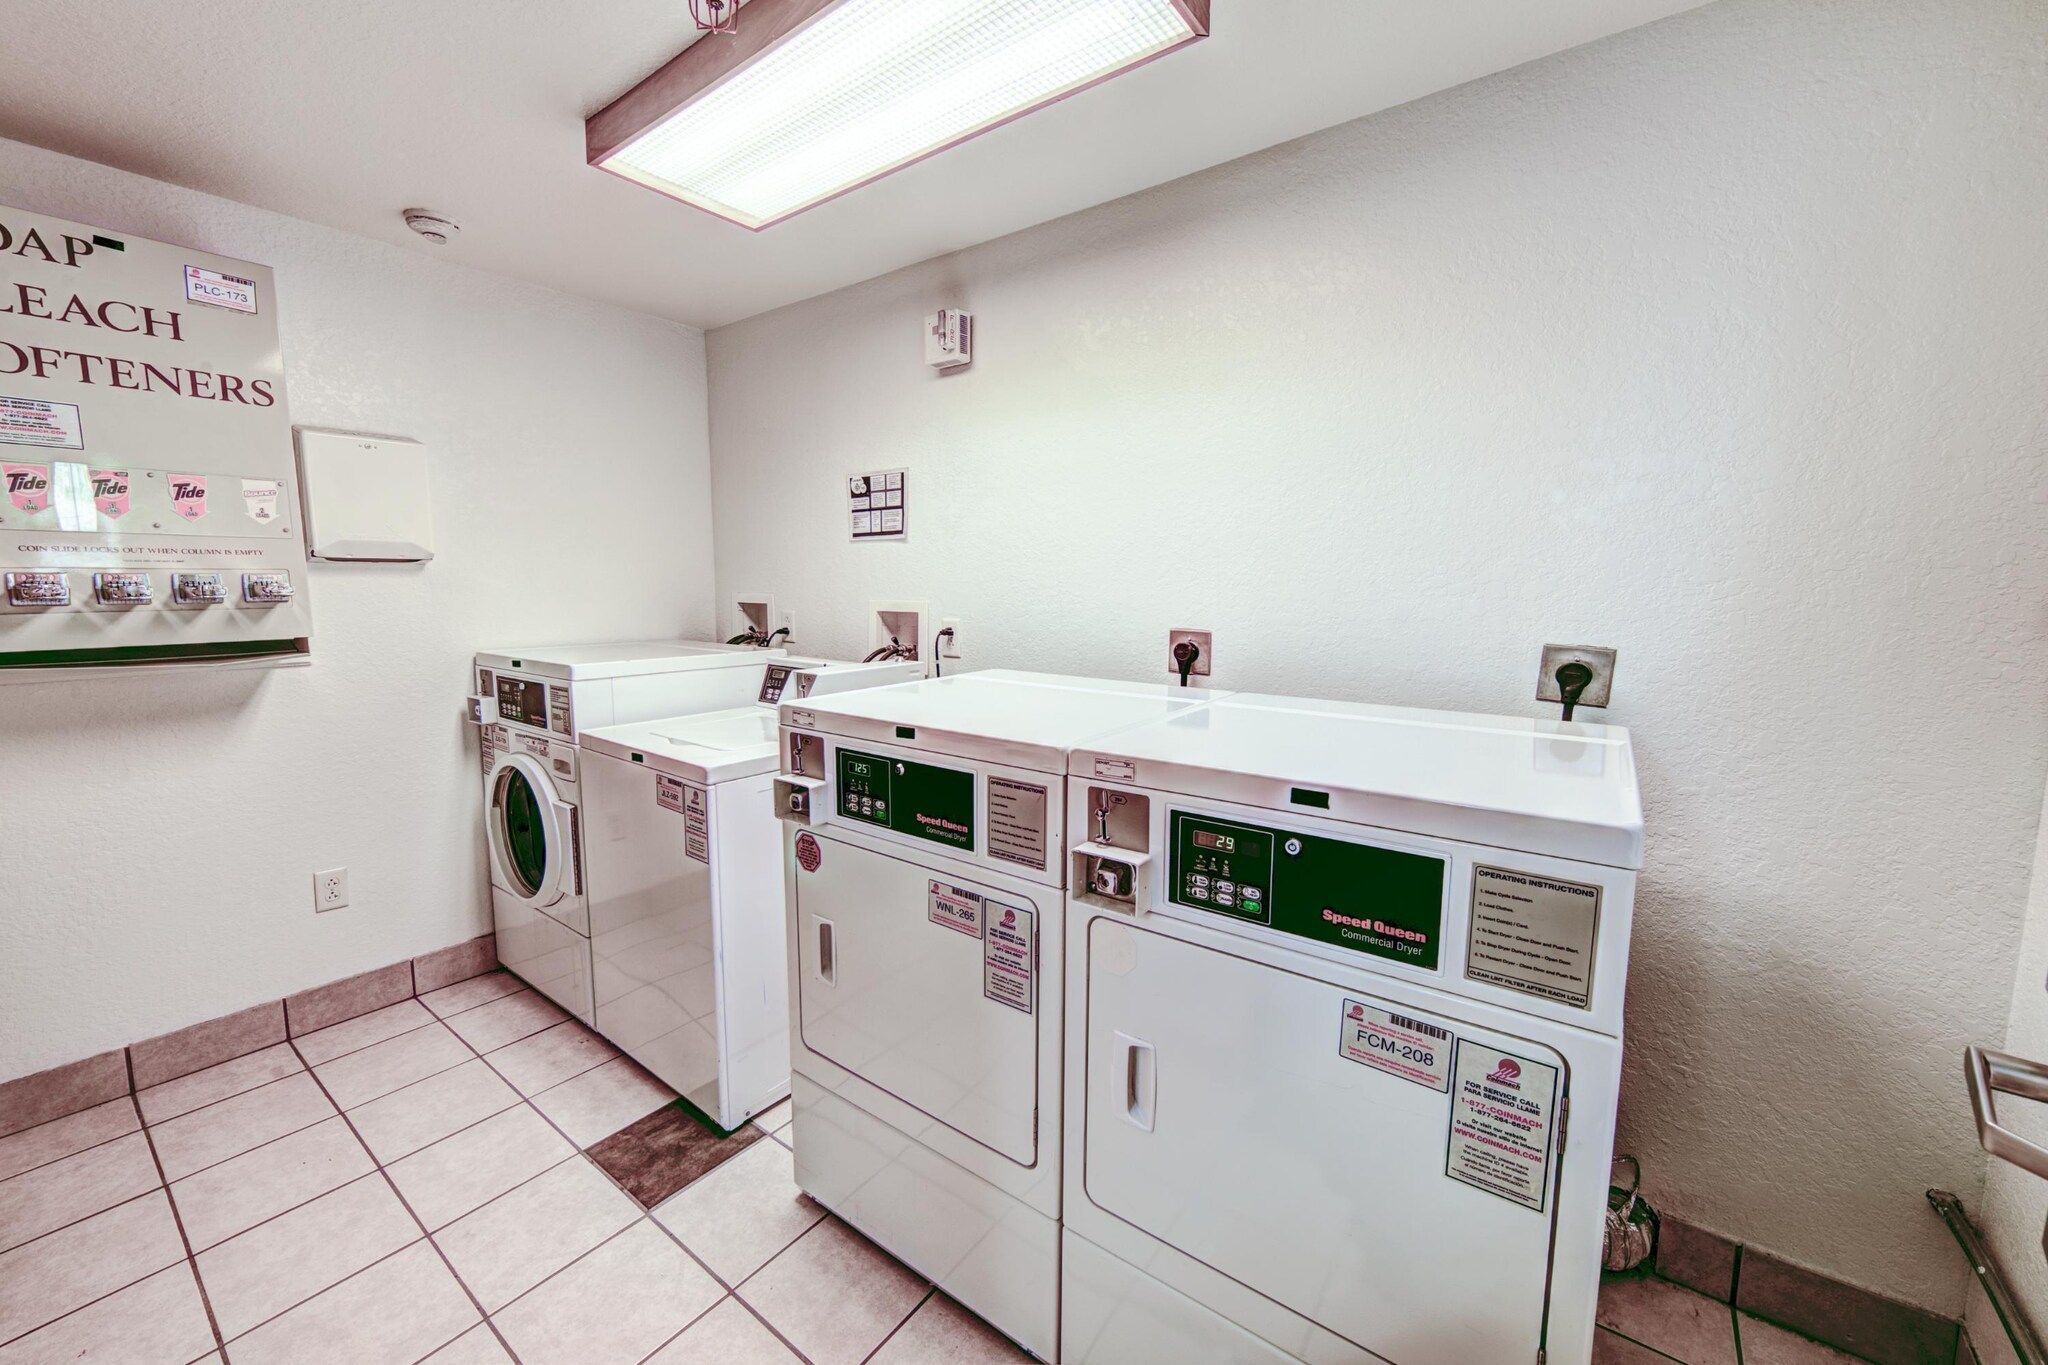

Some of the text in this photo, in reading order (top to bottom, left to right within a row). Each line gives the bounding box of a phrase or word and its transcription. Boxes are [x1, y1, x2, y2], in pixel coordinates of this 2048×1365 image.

[195, 283, 248, 302] PLC-173
[6, 472, 47, 493] Tide
[92, 479, 128, 497] Tide
[172, 483, 205, 501] Tide
[855, 762, 867, 774] 125
[916, 813, 968, 833] Speed Queen
[926, 826, 967, 842] Commercial Dryer
[1216, 835, 1234, 850] 29
[1478, 869, 1594, 898] OPERATING INSTRUCTIONS
[935, 900, 976, 922] WNL-265
[1322, 908, 1427, 943] Speed Queen
[1341, 928, 1422, 956] Commercial Dryer
[1469, 970, 1489, 979] CLEAN
[1504, 979, 1524, 988] FILTER
[1526, 984, 1546, 993] AFTER
[1548, 990, 1565, 998] EACH
[1567, 994, 1585, 1003] LOAD
[1357, 1029, 1434, 1067] FCM-208
[1486, 1074, 1520, 1090] Coinmach
[1464, 1086, 1540, 1116] PARA SERVICIO LLAME
[1465, 1080, 1540, 1110] FOR SERVICE CALL
[1461, 1096, 1542, 1129] 1-877-COINMACH
[1469, 1106, 1531, 1132] 1-877-264-6622
[1461, 1121, 1475, 1130] visite
[1480, 1121, 1491, 1129] visit
[1504, 1130, 1526, 1142] website
[1454, 1126, 1541, 1164] WWW.COINMACH.COM
